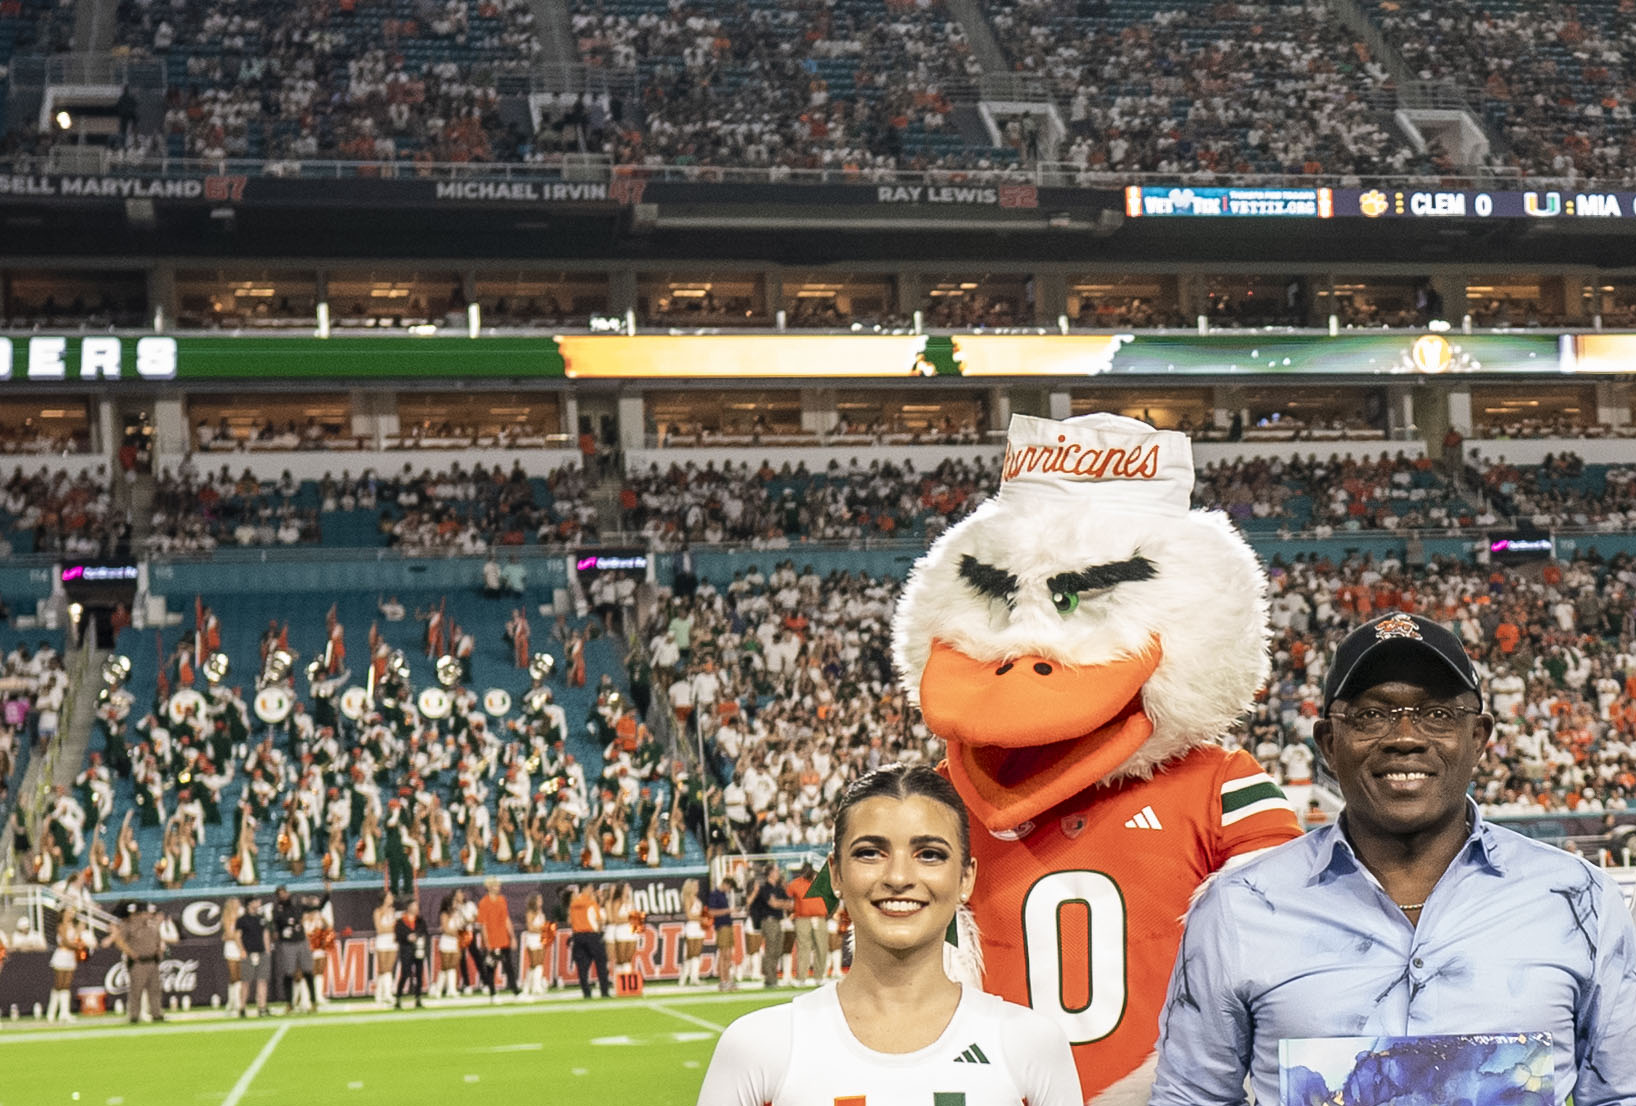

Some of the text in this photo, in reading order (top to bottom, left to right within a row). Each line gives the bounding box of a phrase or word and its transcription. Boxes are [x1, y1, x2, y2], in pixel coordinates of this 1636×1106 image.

[61, 177, 201, 198] MARYLAND
[437, 182, 539, 200] MICHAEL
[543, 184, 607, 201] IRVIN
[878, 186, 923, 203] RAY
[928, 186, 998, 204] LEWIS
[1410, 192, 1493, 217] CLEM 0
[1575, 194, 1622, 218] MIA
[1021, 868, 1129, 1047] 0
[620, 973, 639, 992] 10
